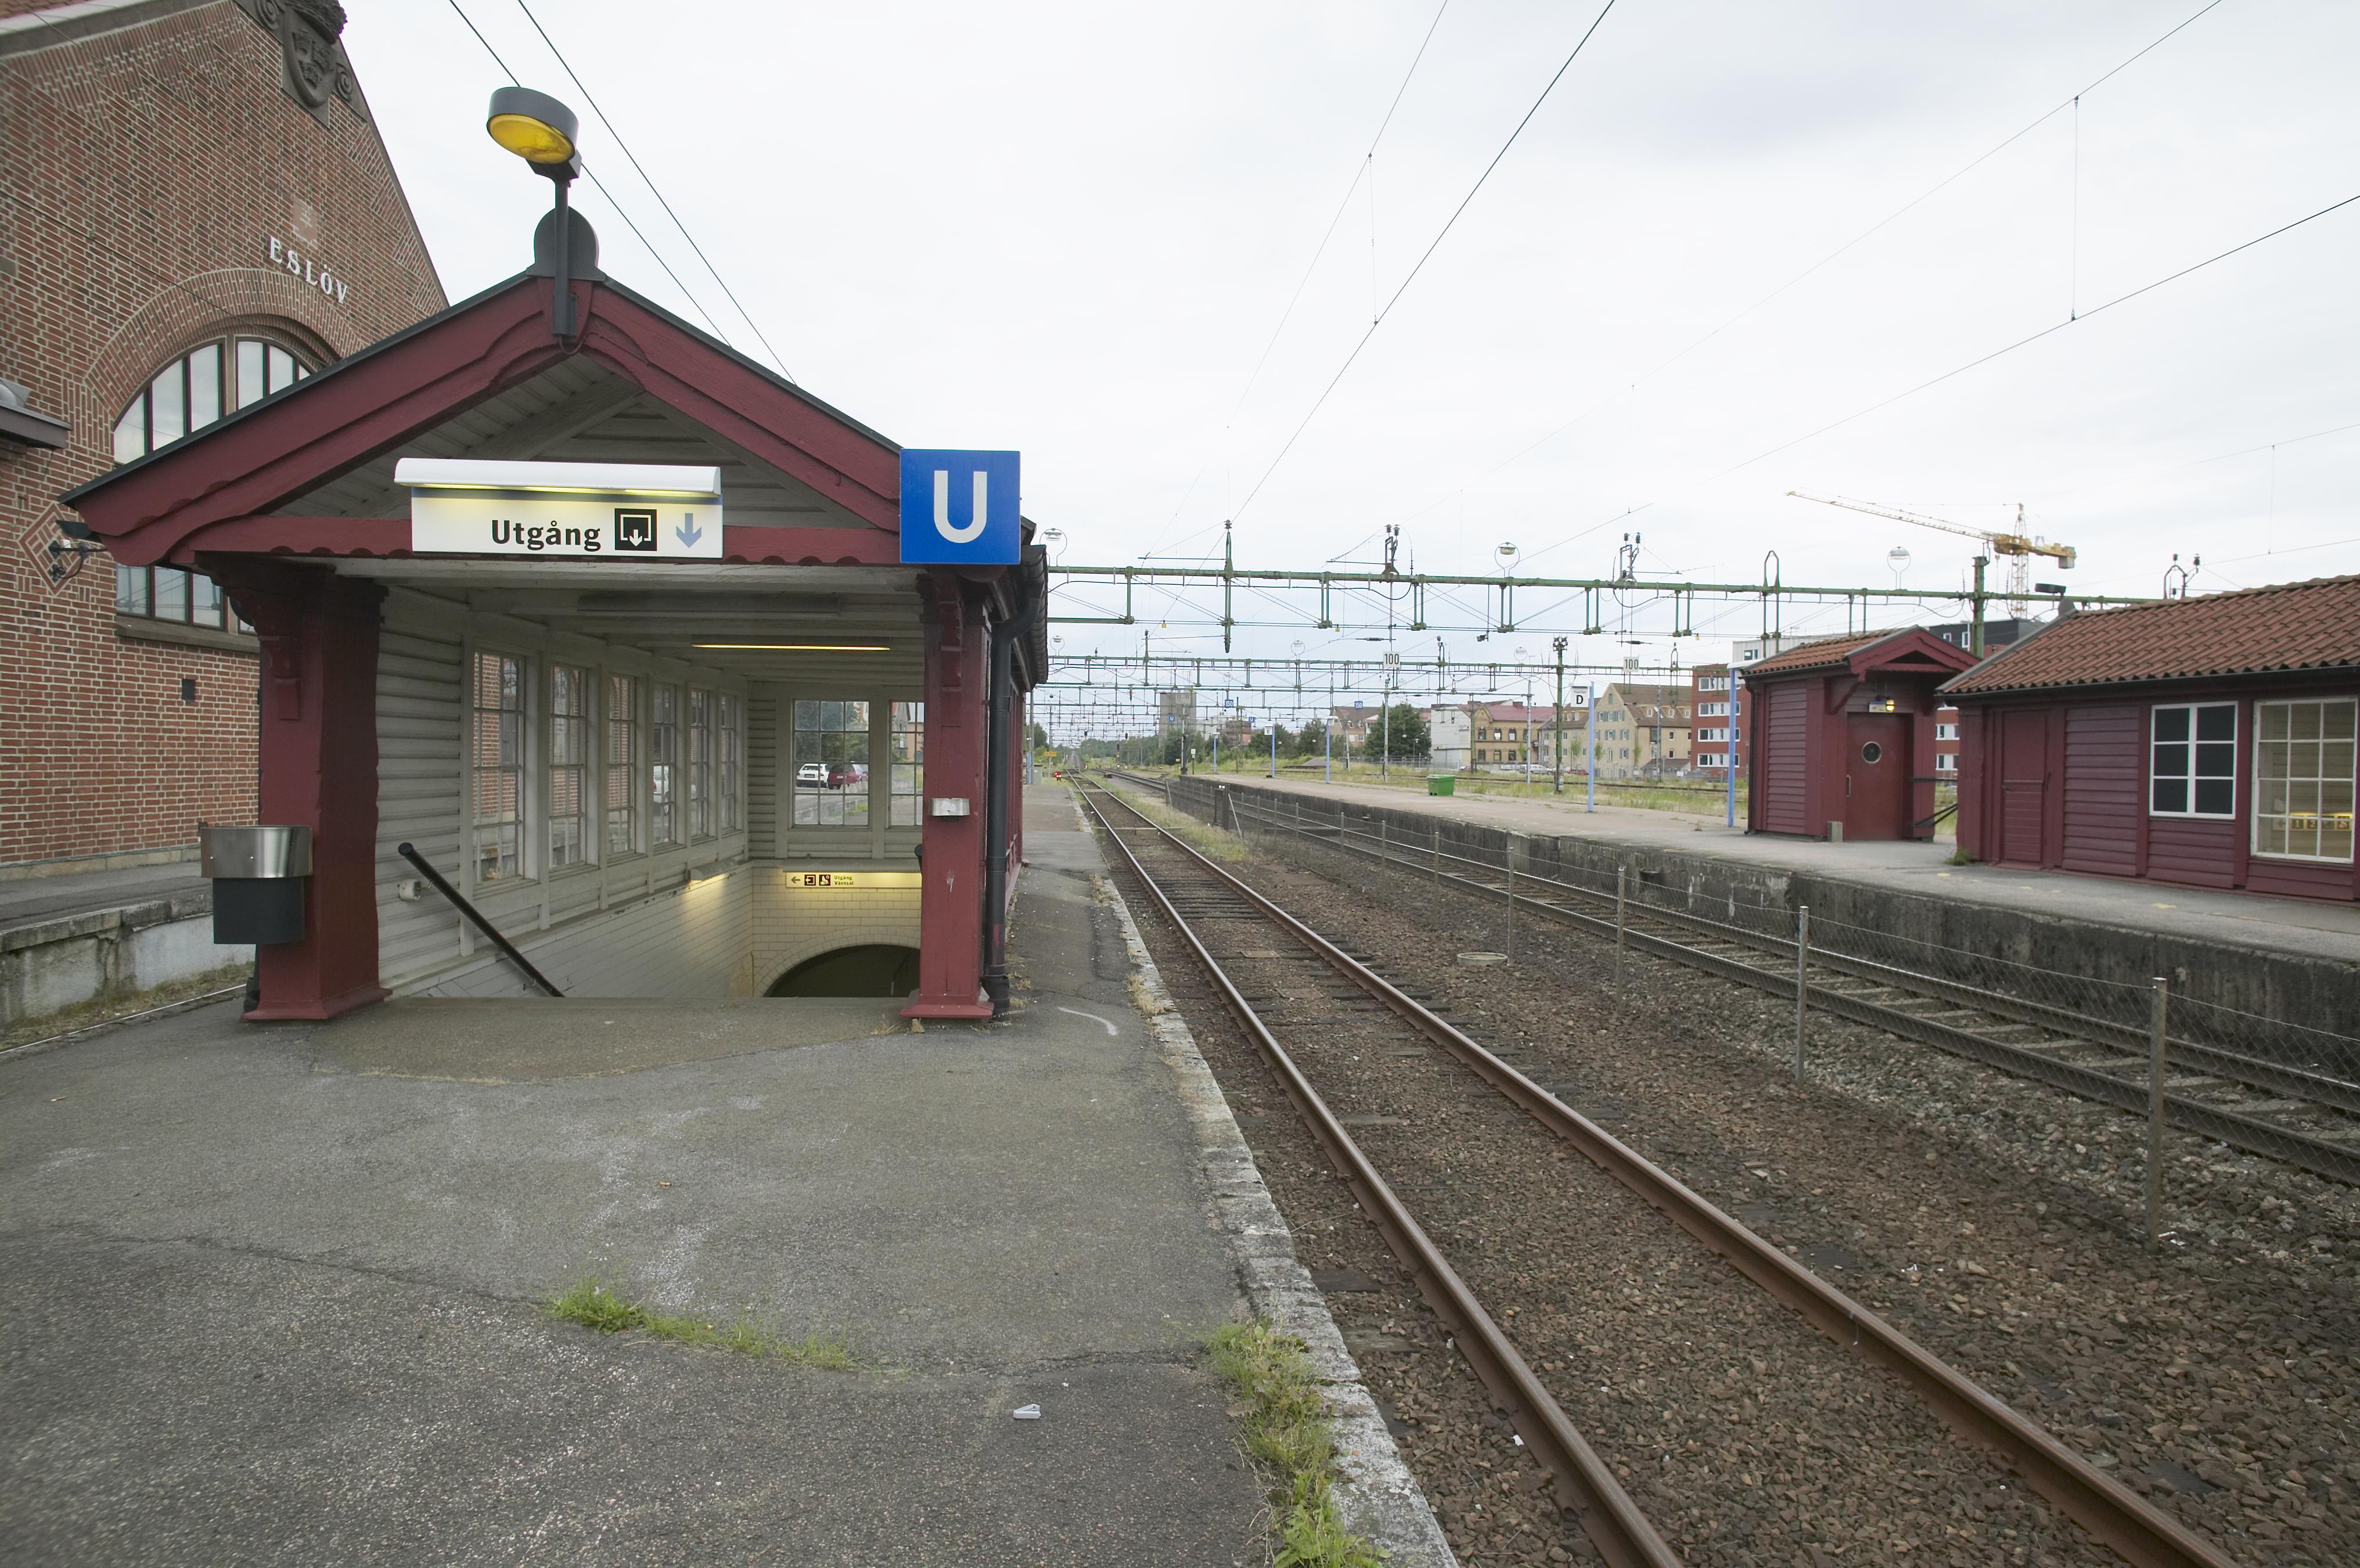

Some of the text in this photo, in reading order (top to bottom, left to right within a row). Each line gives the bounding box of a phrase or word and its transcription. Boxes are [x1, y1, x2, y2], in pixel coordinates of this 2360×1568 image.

[269, 236, 348, 304] ESLÖV
[934, 470, 987, 544] U
[492, 520, 601, 552] Utgång
[1384, 653, 1399, 664] 100
[1625, 659, 1639, 670] 100
[1576, 695, 1584, 704] D
